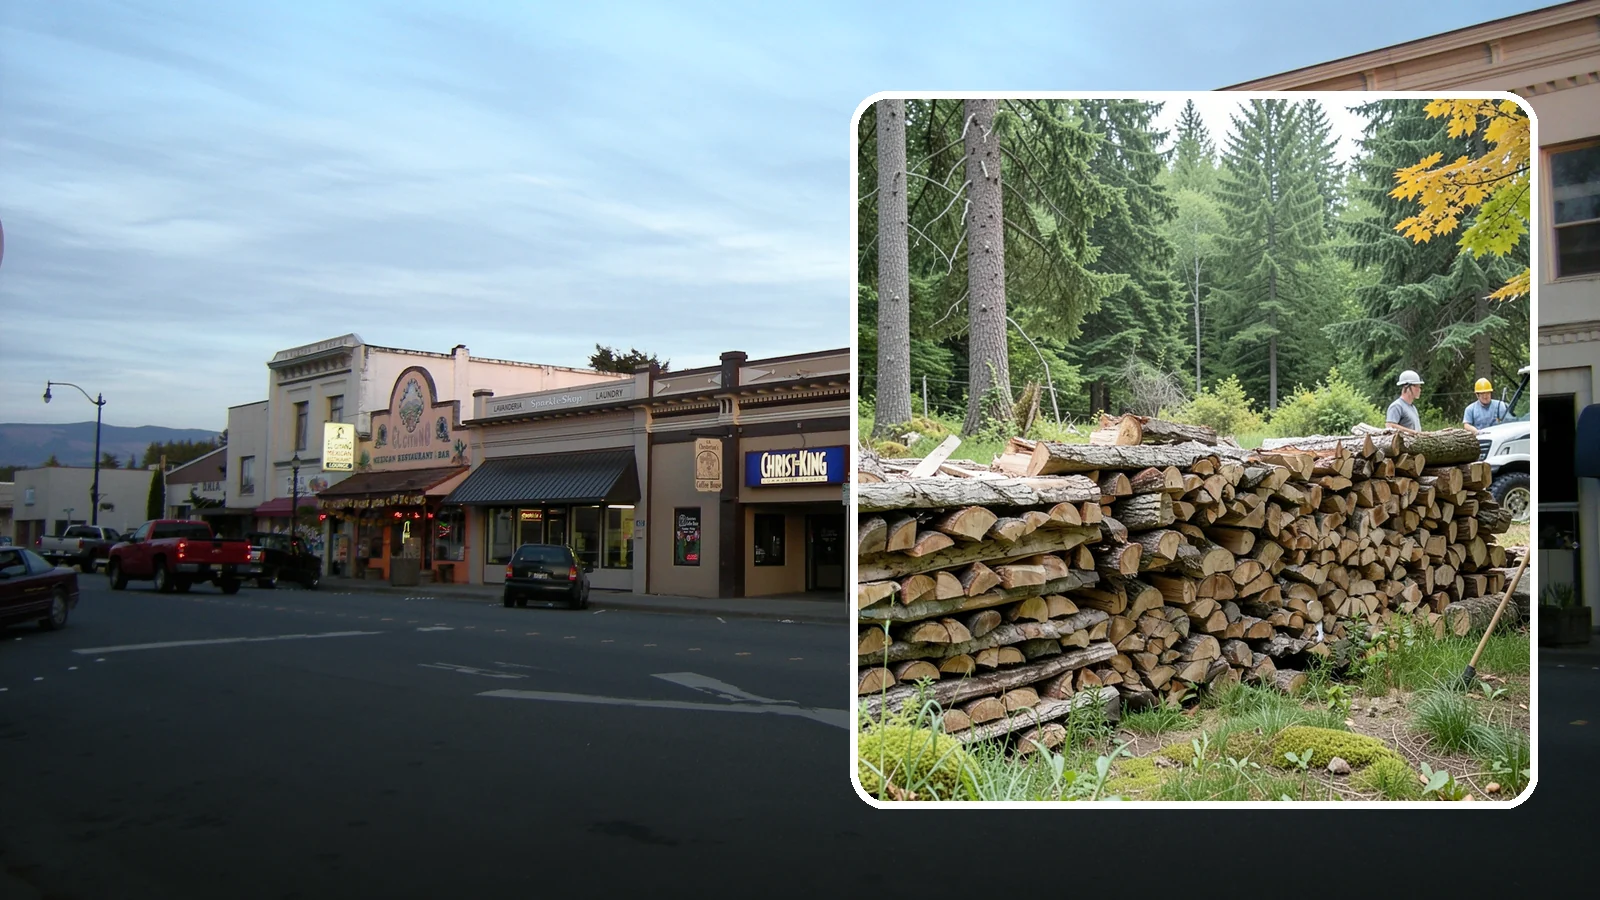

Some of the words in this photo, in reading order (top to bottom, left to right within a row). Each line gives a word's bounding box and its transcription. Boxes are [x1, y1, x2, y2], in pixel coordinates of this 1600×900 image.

[531, 395, 561, 408] Sparkle
[561, 394, 583, 405] Shop
[595, 389, 623, 400] LAUNDRY
[493, 402, 522, 412] LAVANDERIA
[373, 455, 396, 464] MEXICAN
[397, 452, 433, 462] RESTAURANT
[438, 450, 450, 459] BAR
[761, 452, 797, 478] CHRIST
[799, 450, 827, 476] KING
